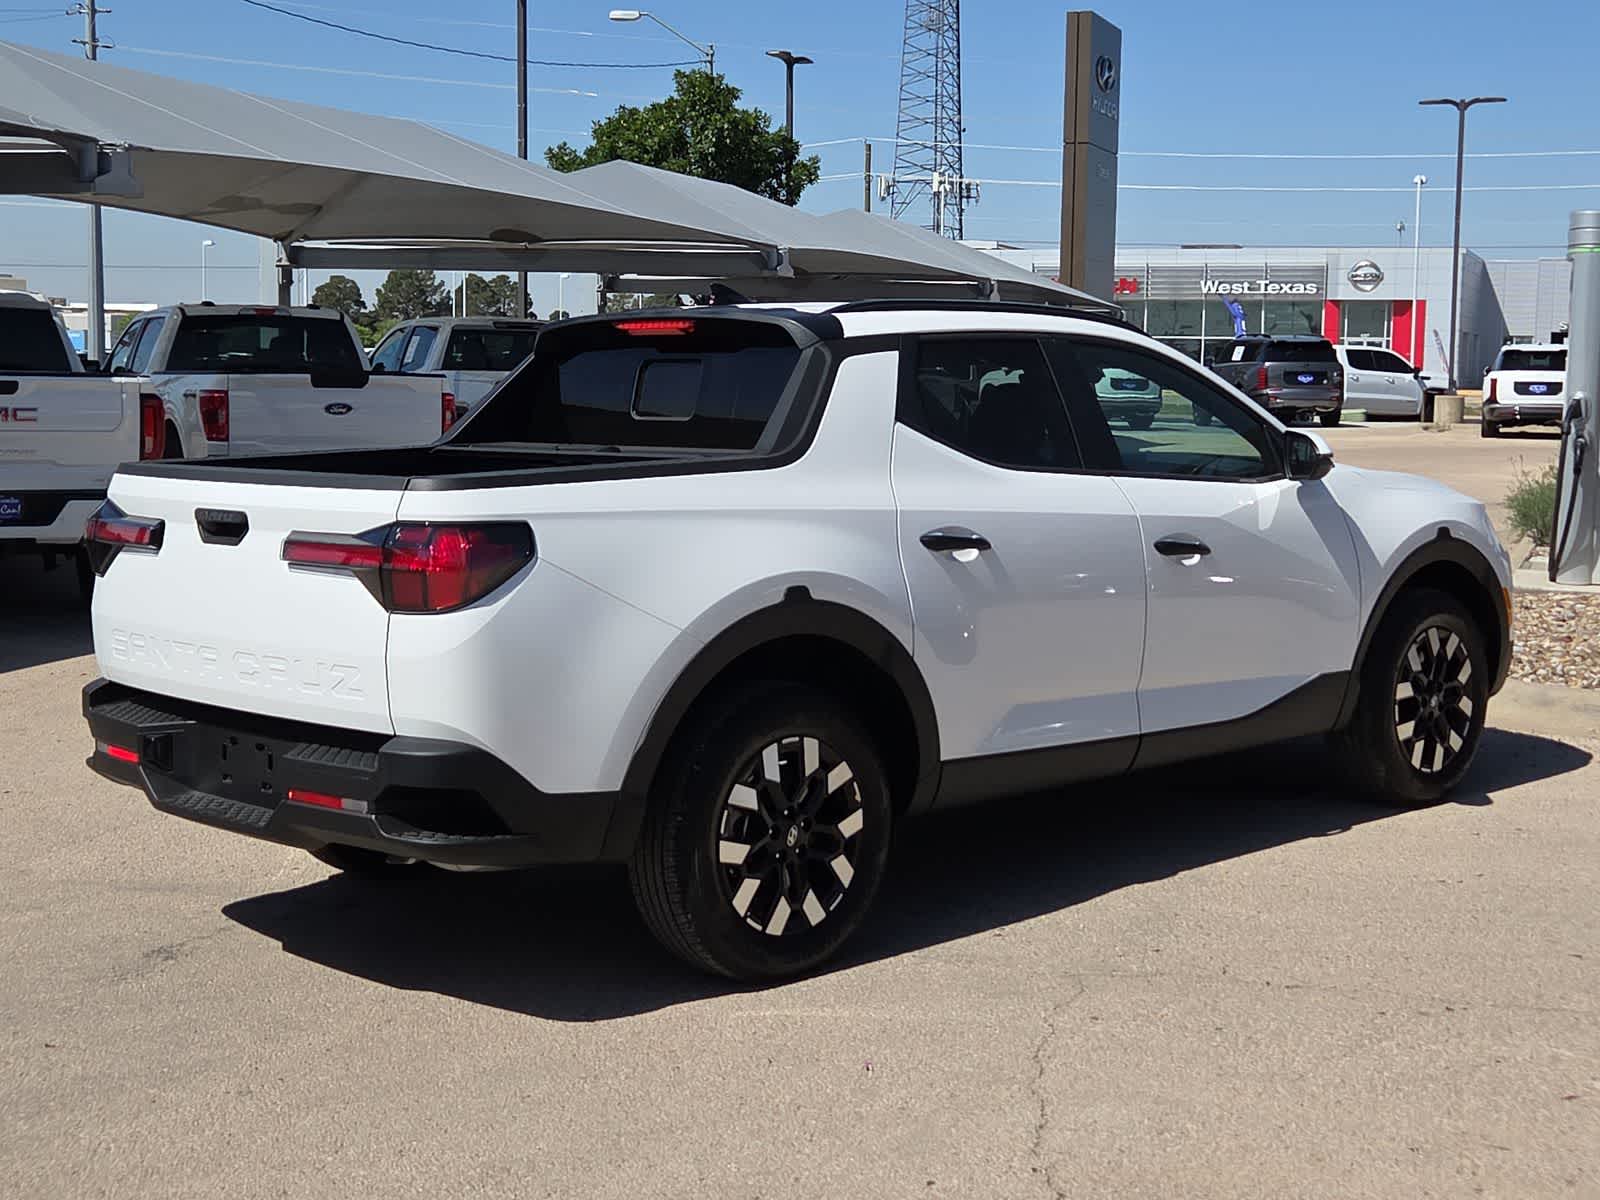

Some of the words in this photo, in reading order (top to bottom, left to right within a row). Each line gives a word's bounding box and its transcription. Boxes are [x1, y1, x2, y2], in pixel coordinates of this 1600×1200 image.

[1200, 280, 1250, 294] West
[1256, 280, 1318, 294] Texas
[111, 628, 224, 680] SANTA
[231, 650, 366, 700] CRUZ
